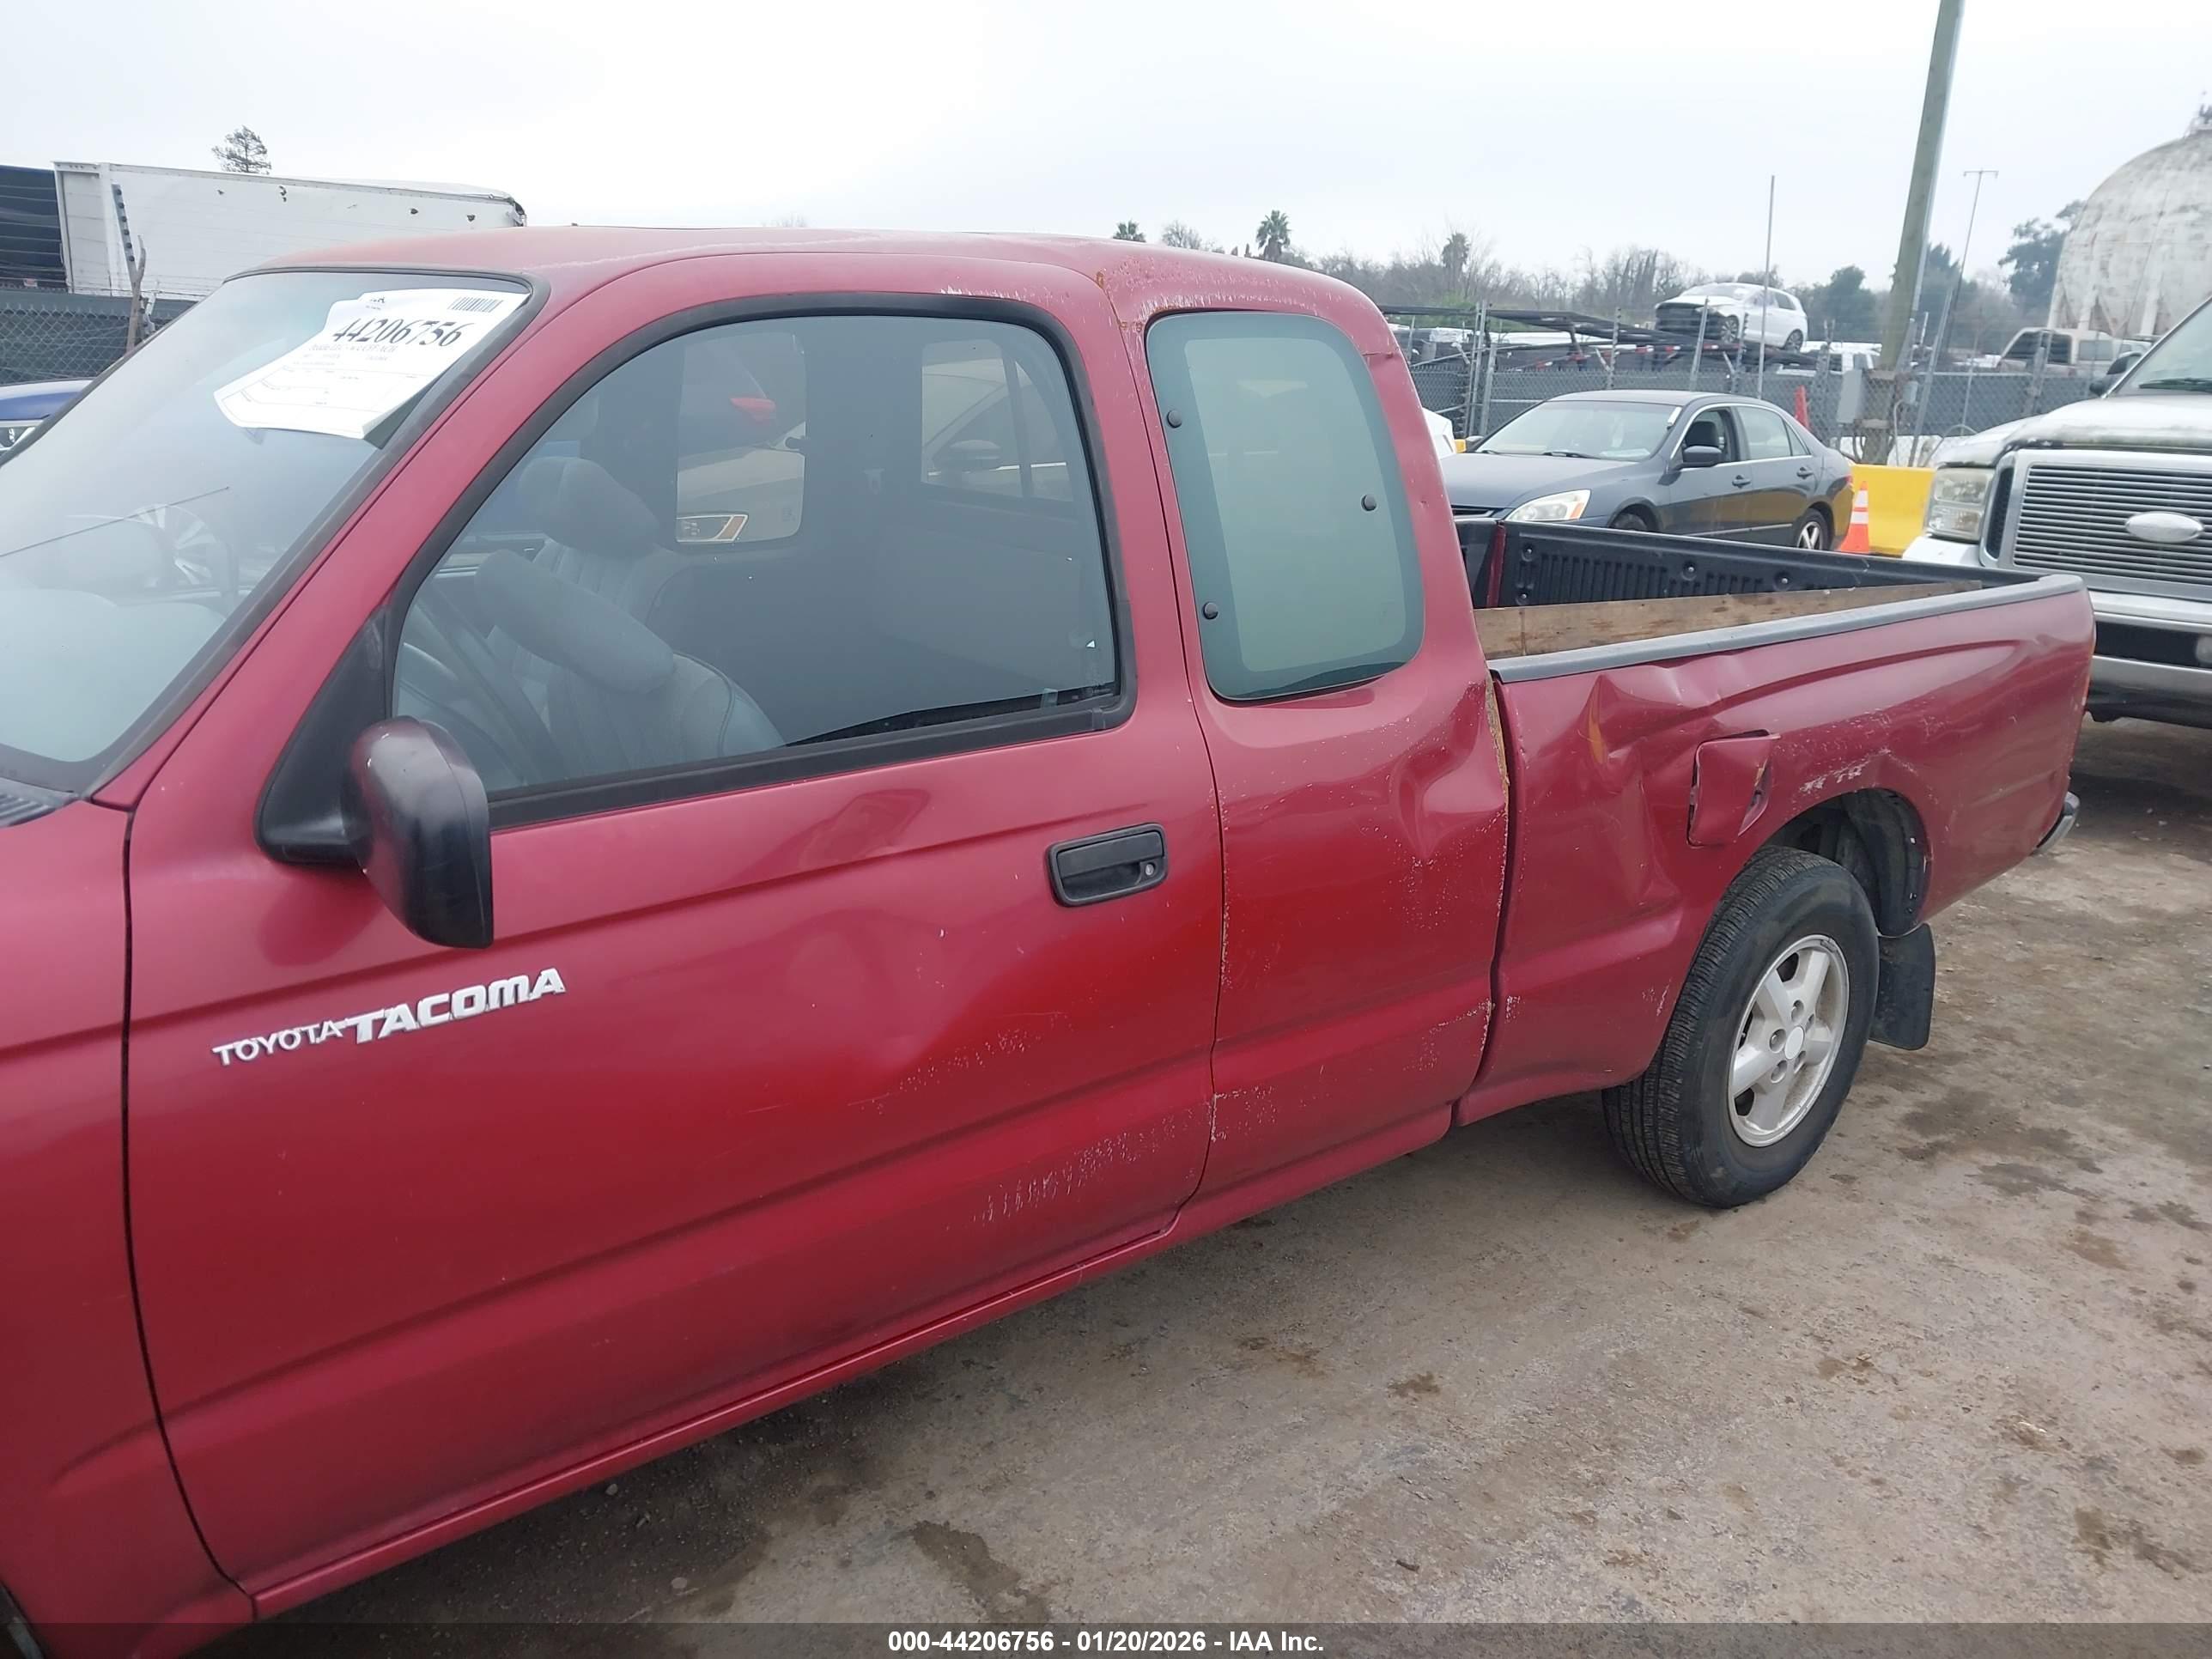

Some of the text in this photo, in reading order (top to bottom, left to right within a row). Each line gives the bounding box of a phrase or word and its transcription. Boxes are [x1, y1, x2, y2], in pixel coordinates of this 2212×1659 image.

[333, 318, 475, 347] 44206756
[212, 968, 567, 1066] TOYOTA TACOMA
